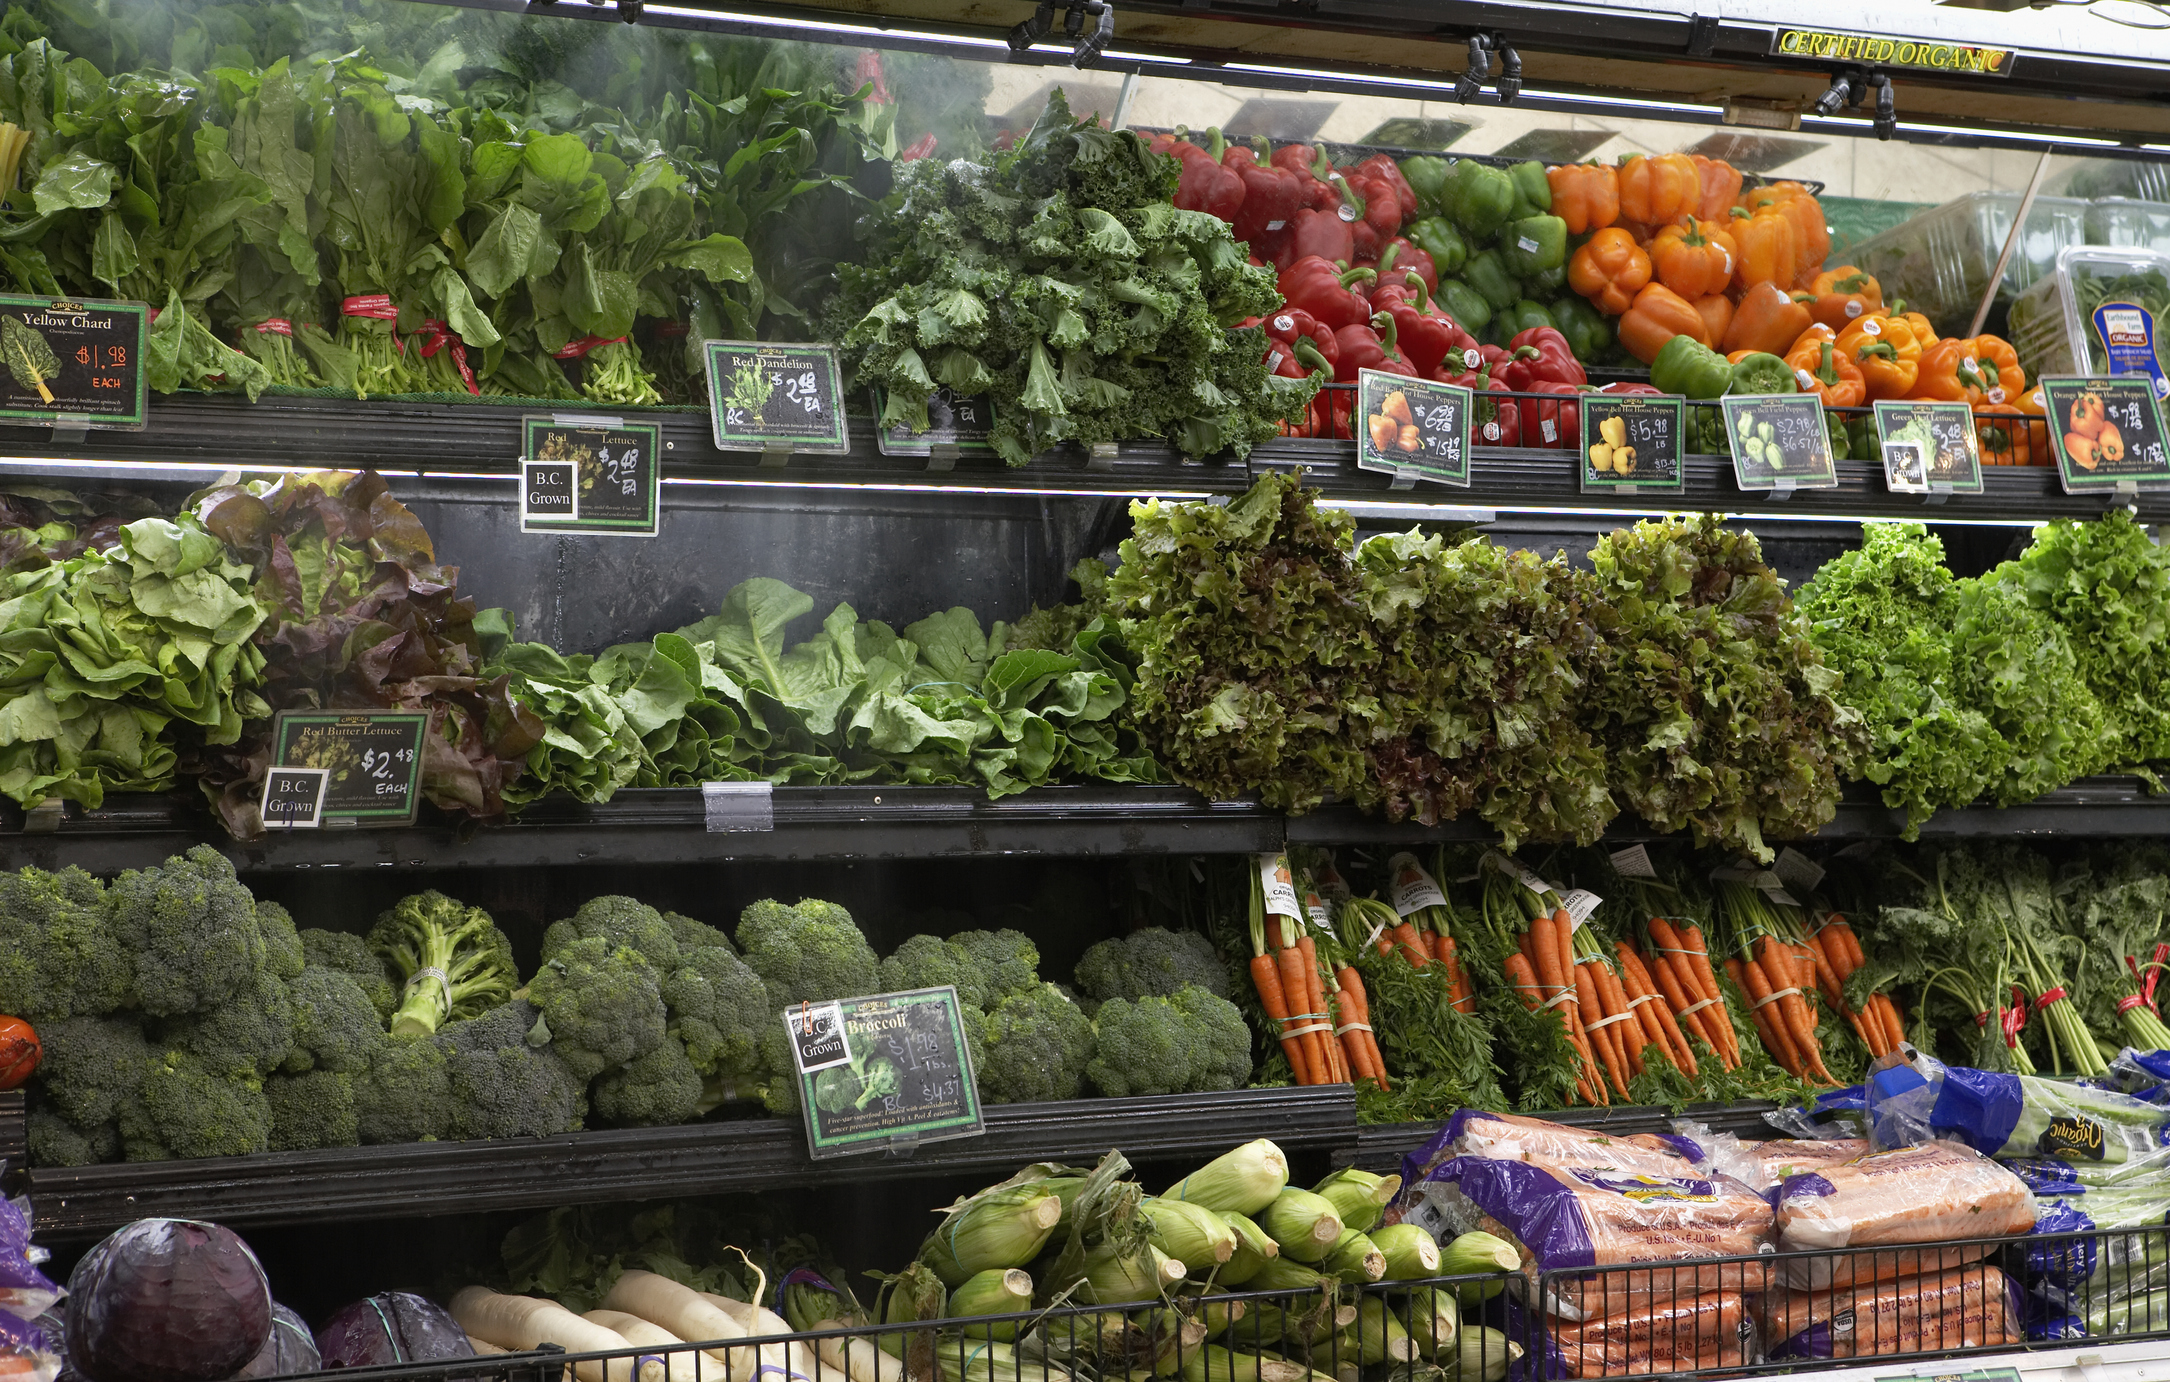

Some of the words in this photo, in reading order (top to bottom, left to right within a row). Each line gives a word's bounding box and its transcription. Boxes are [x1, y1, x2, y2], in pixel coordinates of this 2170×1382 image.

[1780, 31, 1894, 62] CERTIFIED
[1899, 43, 2004, 73] ORGANIC
[52, 302, 84, 311] CHOICES
[23, 312, 68, 327] Yellow
[71, 315, 112, 330] Chard
[2106, 312, 2139, 322] Earthbound
[2112, 333, 2144, 343] ORGANIC
[732, 356, 755, 367] Red
[757, 357, 813, 370] Dandelion
[92, 377, 121, 389] EACH
[1370, 383, 1384, 392] Red
[1414, 390, 1434, 401] House
[1436, 394, 1461, 405] Peppers
[2053, 391, 2077, 400] Orange
[2123, 391, 2147, 400] Peppers
[1653, 407, 1675, 415] Peppers
[1785, 406, 1808, 414] Peppers
[1891, 413, 1912, 421] Green
[1931, 414, 1957, 422] Lettuce
[547, 431, 567, 442] Red
[602, 435, 638, 446] Lettuce
[536, 472, 563, 485] B.C.
[1891, 467, 1921, 478] Grown
[529, 492, 570, 505] Grown
[340, 715, 369, 723] CHOICES
[303, 726, 325, 736] Red
[327, 726, 361, 736] Butter
[362, 726, 403, 735] Lettuce
[279, 780, 309, 793] B.C.
[375, 783, 408, 795] EACH
[269, 799, 313, 812] Grown
[1401, 885, 1433, 901] CARROTS
[858, 1001, 888, 1011] CHOICES
[847, 1013, 907, 1034] Broccoli
[802, 1040, 842, 1058] Grown
[884, 1107, 905, 1116] Loaded
[906, 1105, 918, 1113] with
[918, 1101, 953, 1111] antioxidants
[829, 1125, 848, 1134] cancer
[881, 1116, 896, 1126] High
[914, 1111, 926, 1120] Peel
[2050, 1112, 2102, 1149] Organic
[1617, 1224, 1650, 1233] Produce
[1660, 1222, 1683, 1231] U.S.A.
[1646, 1235, 1662, 1245] U.S.
[1704, 1234, 1716, 1242] No
[1717, 1234, 1721, 1242] 1
[1906, 1296, 1913, 1307] 5
[1680, 1324, 1692, 1332] No
[1837, 1318, 1853, 1326] USDA
[1654, 1347, 1665, 1358] 80
[1677, 1343, 1683, 1353] 5
[1684, 1340, 1693, 1352] lb
